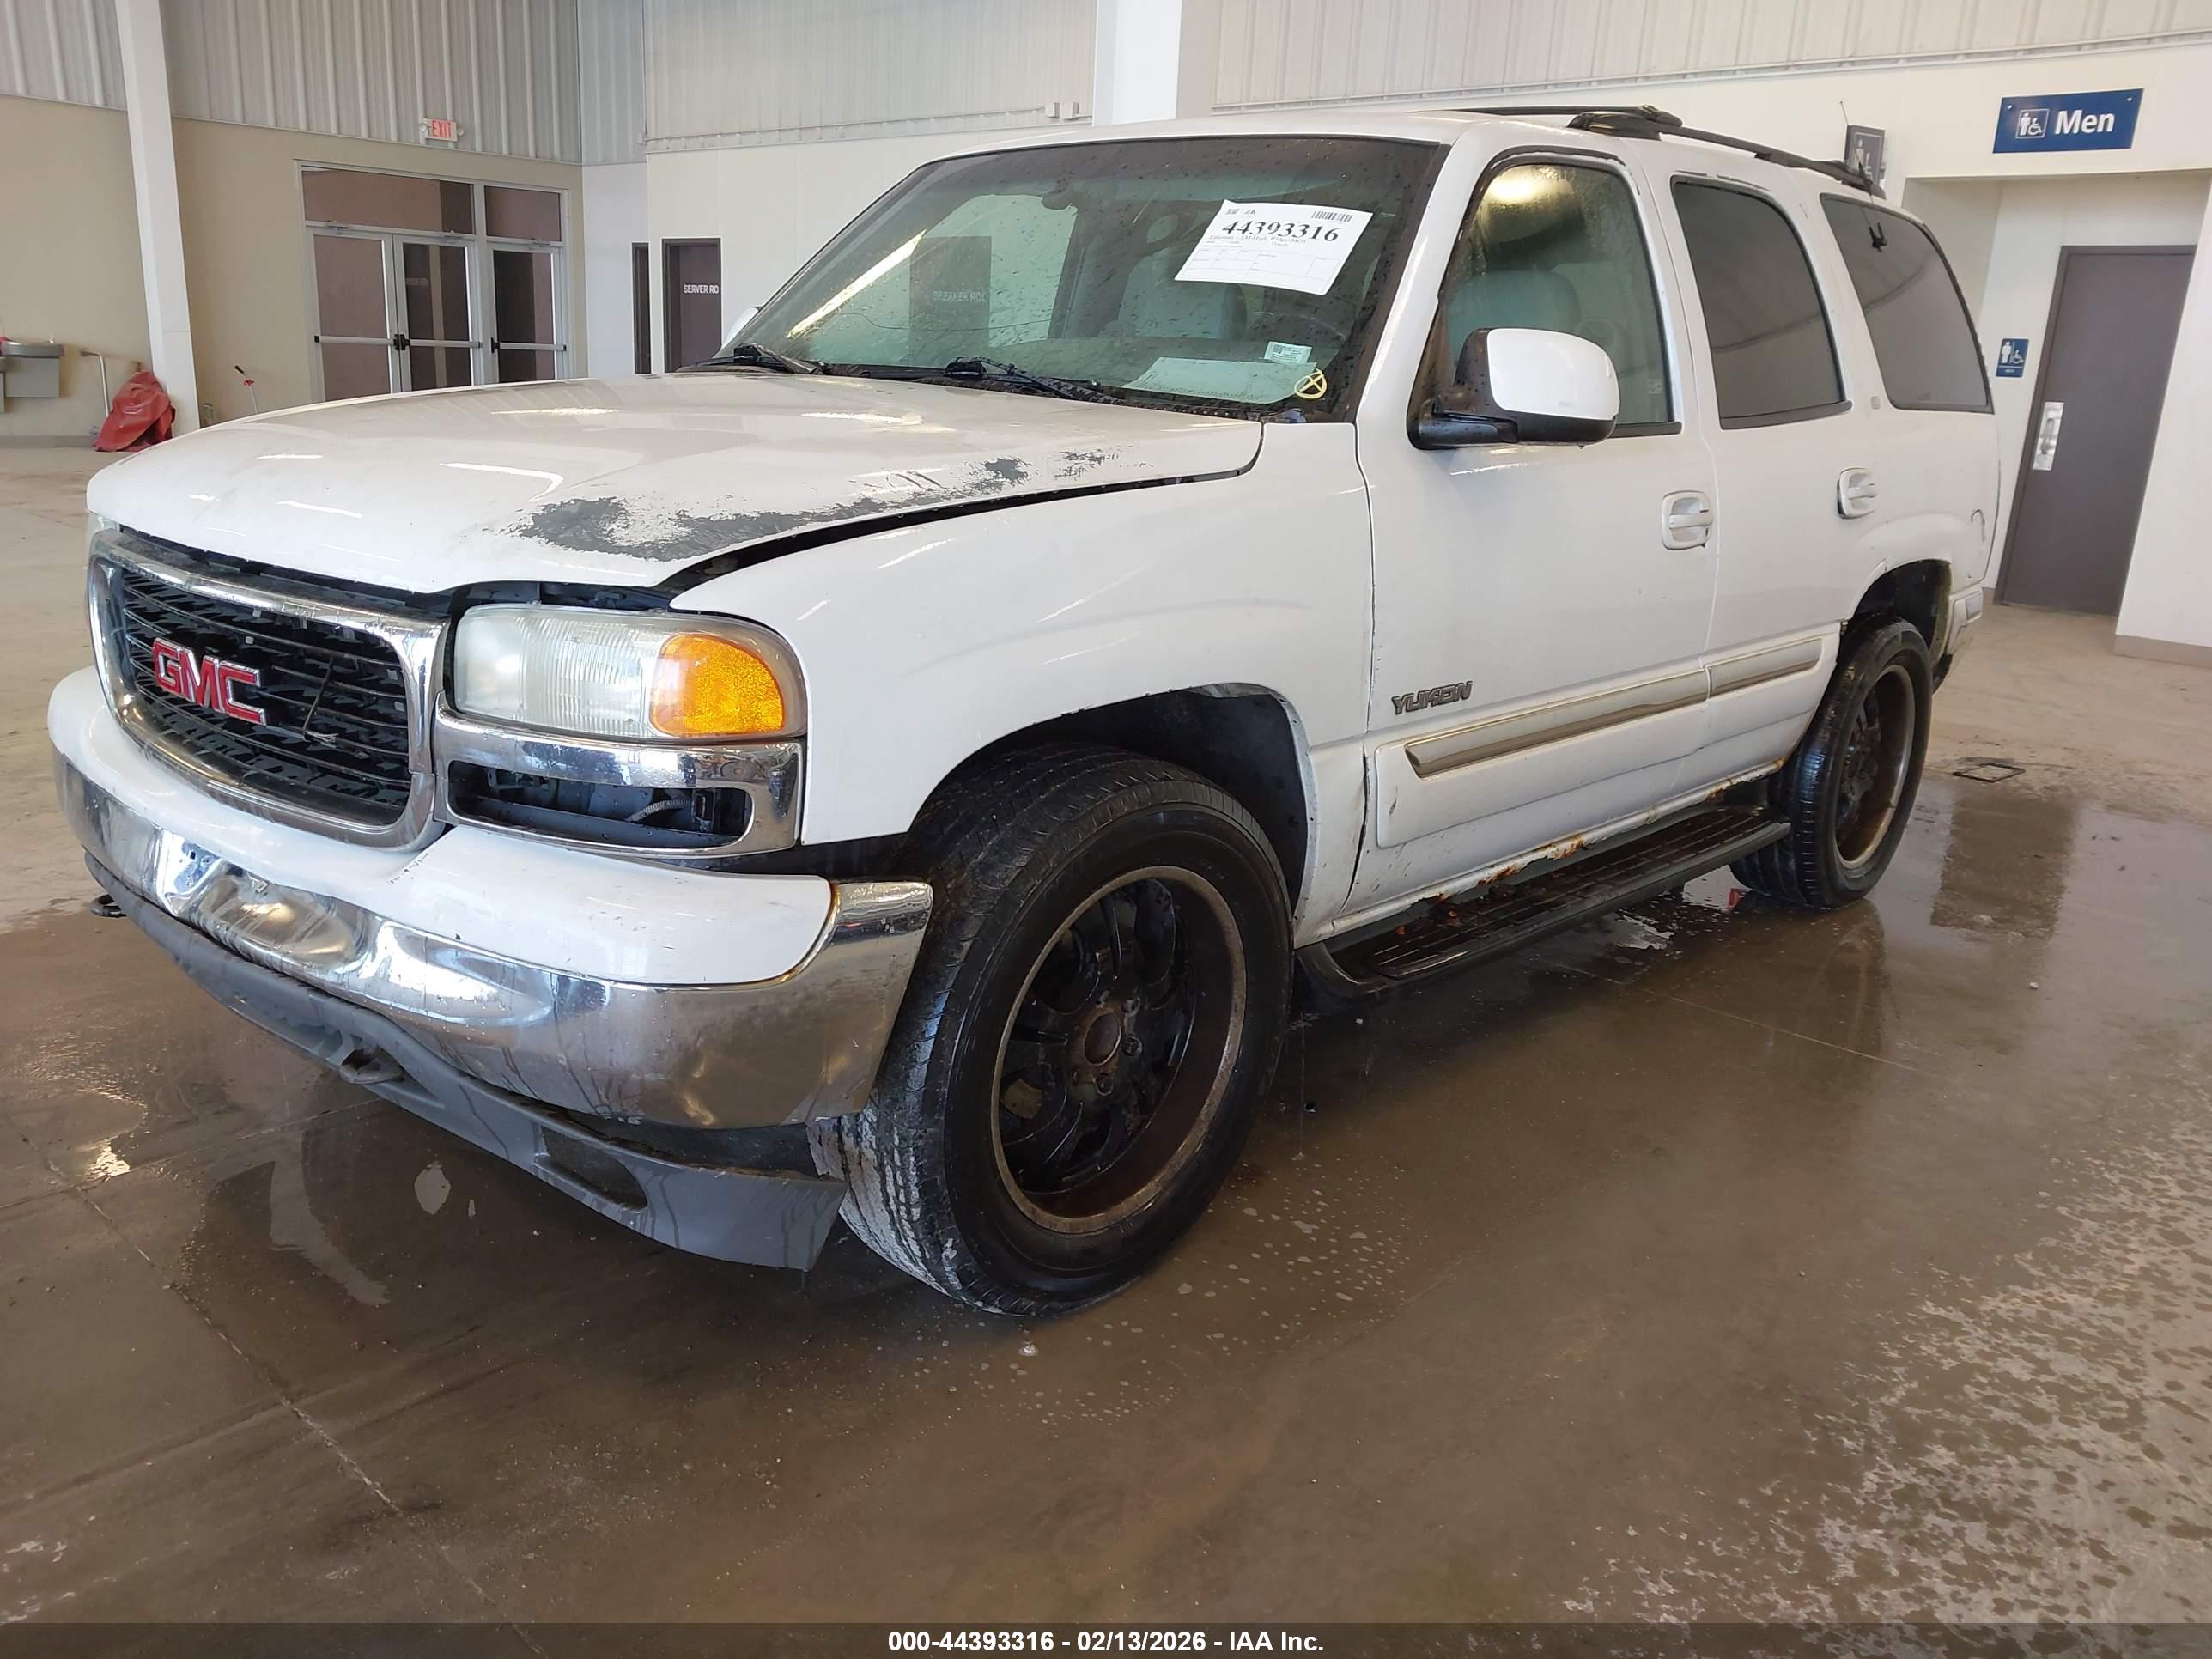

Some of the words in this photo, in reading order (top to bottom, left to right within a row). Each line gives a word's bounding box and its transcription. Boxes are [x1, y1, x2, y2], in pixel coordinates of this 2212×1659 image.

[432, 120, 452, 138] EXIT
[2055, 109, 2115, 135] Men
[1222, 220, 1343, 242] 44393316
[683, 284, 708, 294] SERVER
[152, 637, 267, 726] GMC
[1391, 681, 1473, 715] YUKON
